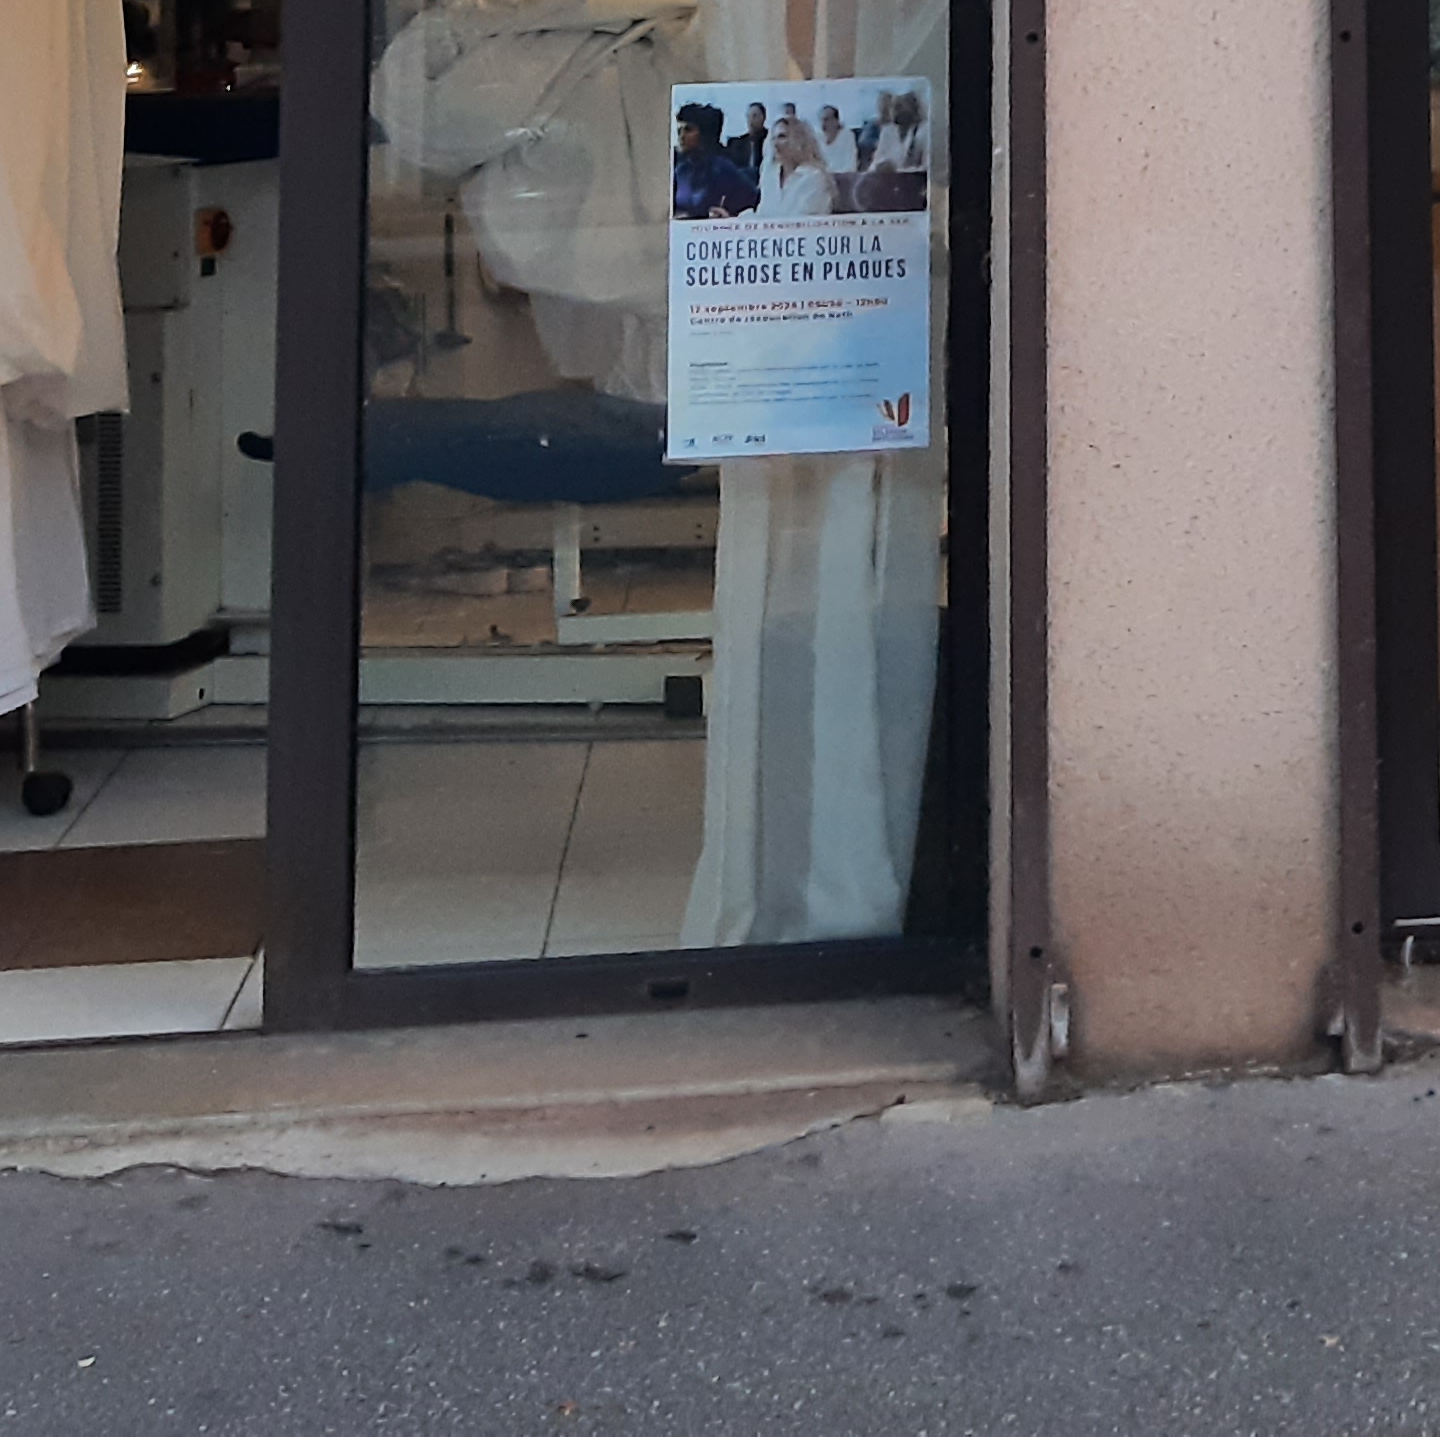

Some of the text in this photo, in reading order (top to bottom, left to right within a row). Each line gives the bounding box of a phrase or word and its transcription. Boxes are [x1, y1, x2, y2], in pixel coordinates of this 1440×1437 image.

[815, 234, 851, 257] SUR
[859, 234, 883, 254] LA
[685, 257, 907, 287] SCLÉROSE EN PLAQUES
